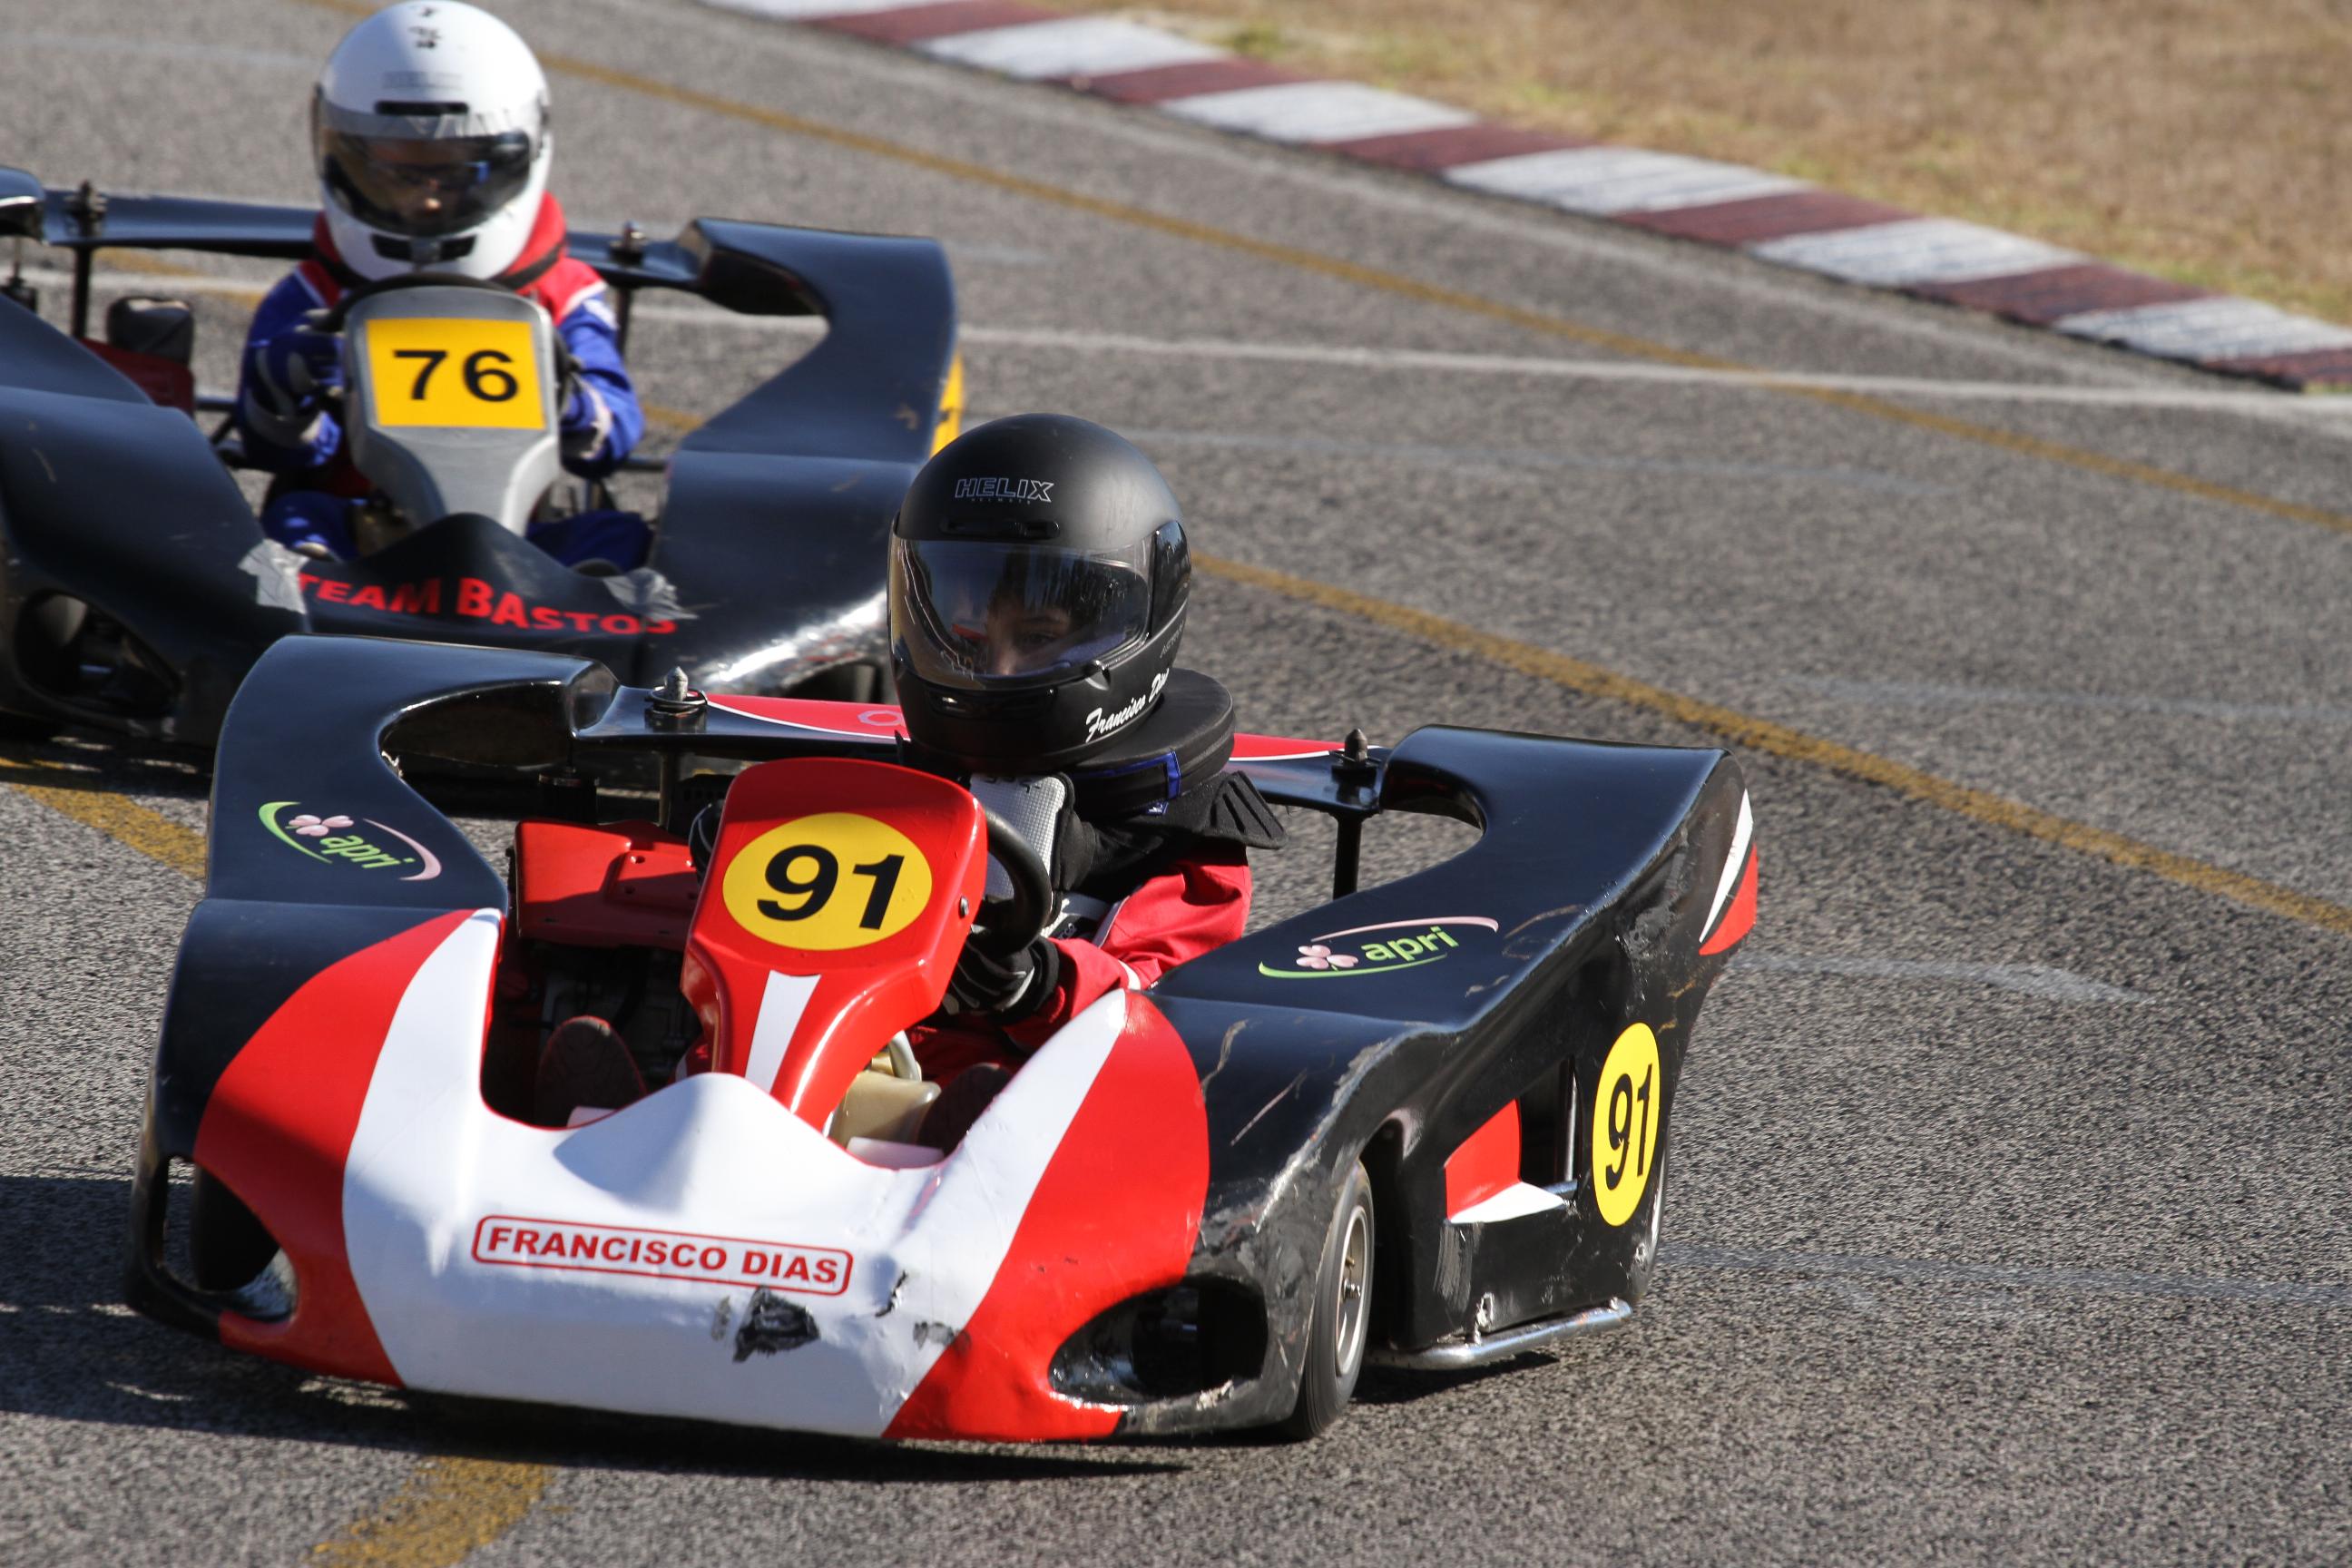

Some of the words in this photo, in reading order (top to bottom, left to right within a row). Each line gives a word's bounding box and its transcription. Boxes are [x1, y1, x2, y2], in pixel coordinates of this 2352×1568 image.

[393, 349, 518, 403] 76
[955, 477, 1054, 503] HELIX
[1085, 695, 1146, 744] Francisco
[319, 835, 415, 868] apri
[757, 844, 905, 930] 91
[1361, 926, 1459, 962] apri
[1605, 1063, 1652, 1191] 91
[487, 1226, 728, 1270] FRANCISCO
[741, 1250, 838, 1284] DIAS
